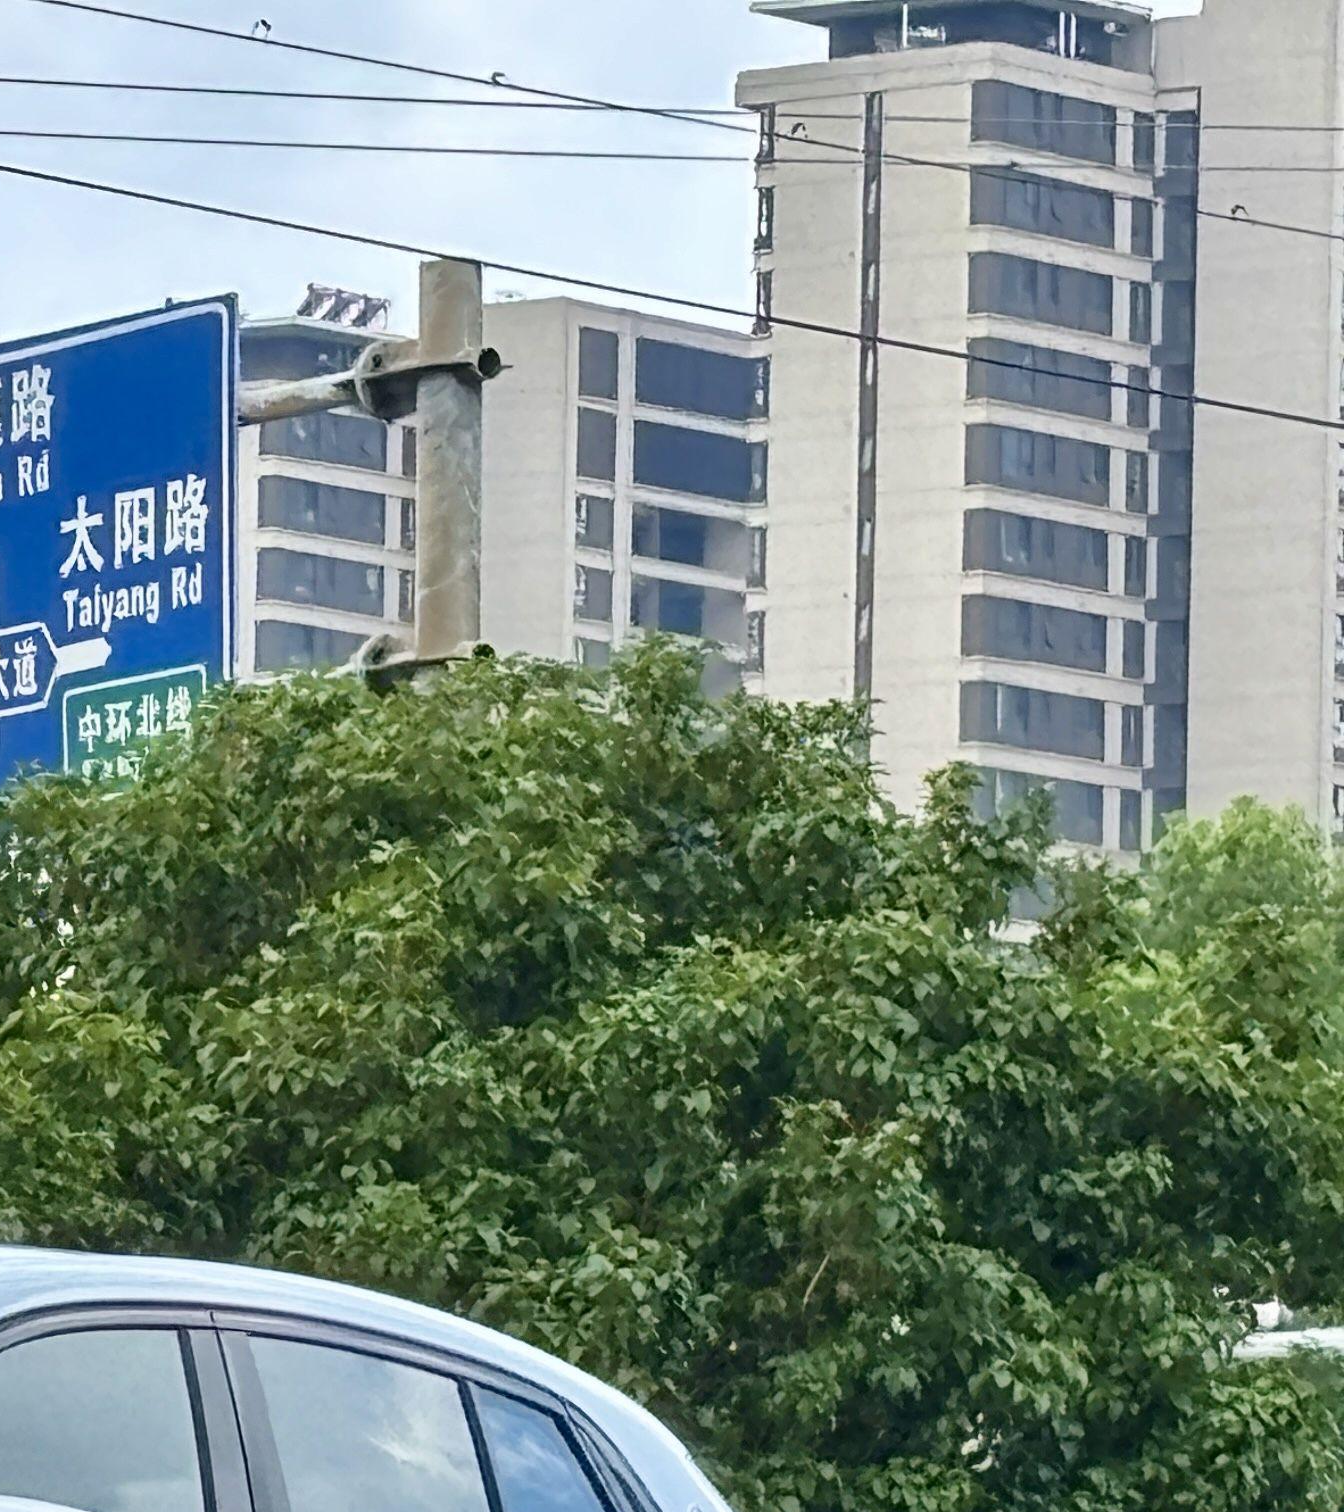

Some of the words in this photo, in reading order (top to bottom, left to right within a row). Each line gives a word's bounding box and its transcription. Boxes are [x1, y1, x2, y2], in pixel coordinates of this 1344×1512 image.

[17, 449, 50, 497] Rd
[59, 473, 209, 578] 太阳路
[63, 583, 160, 633] Taiyang
[171, 562, 202, 610] Rd
